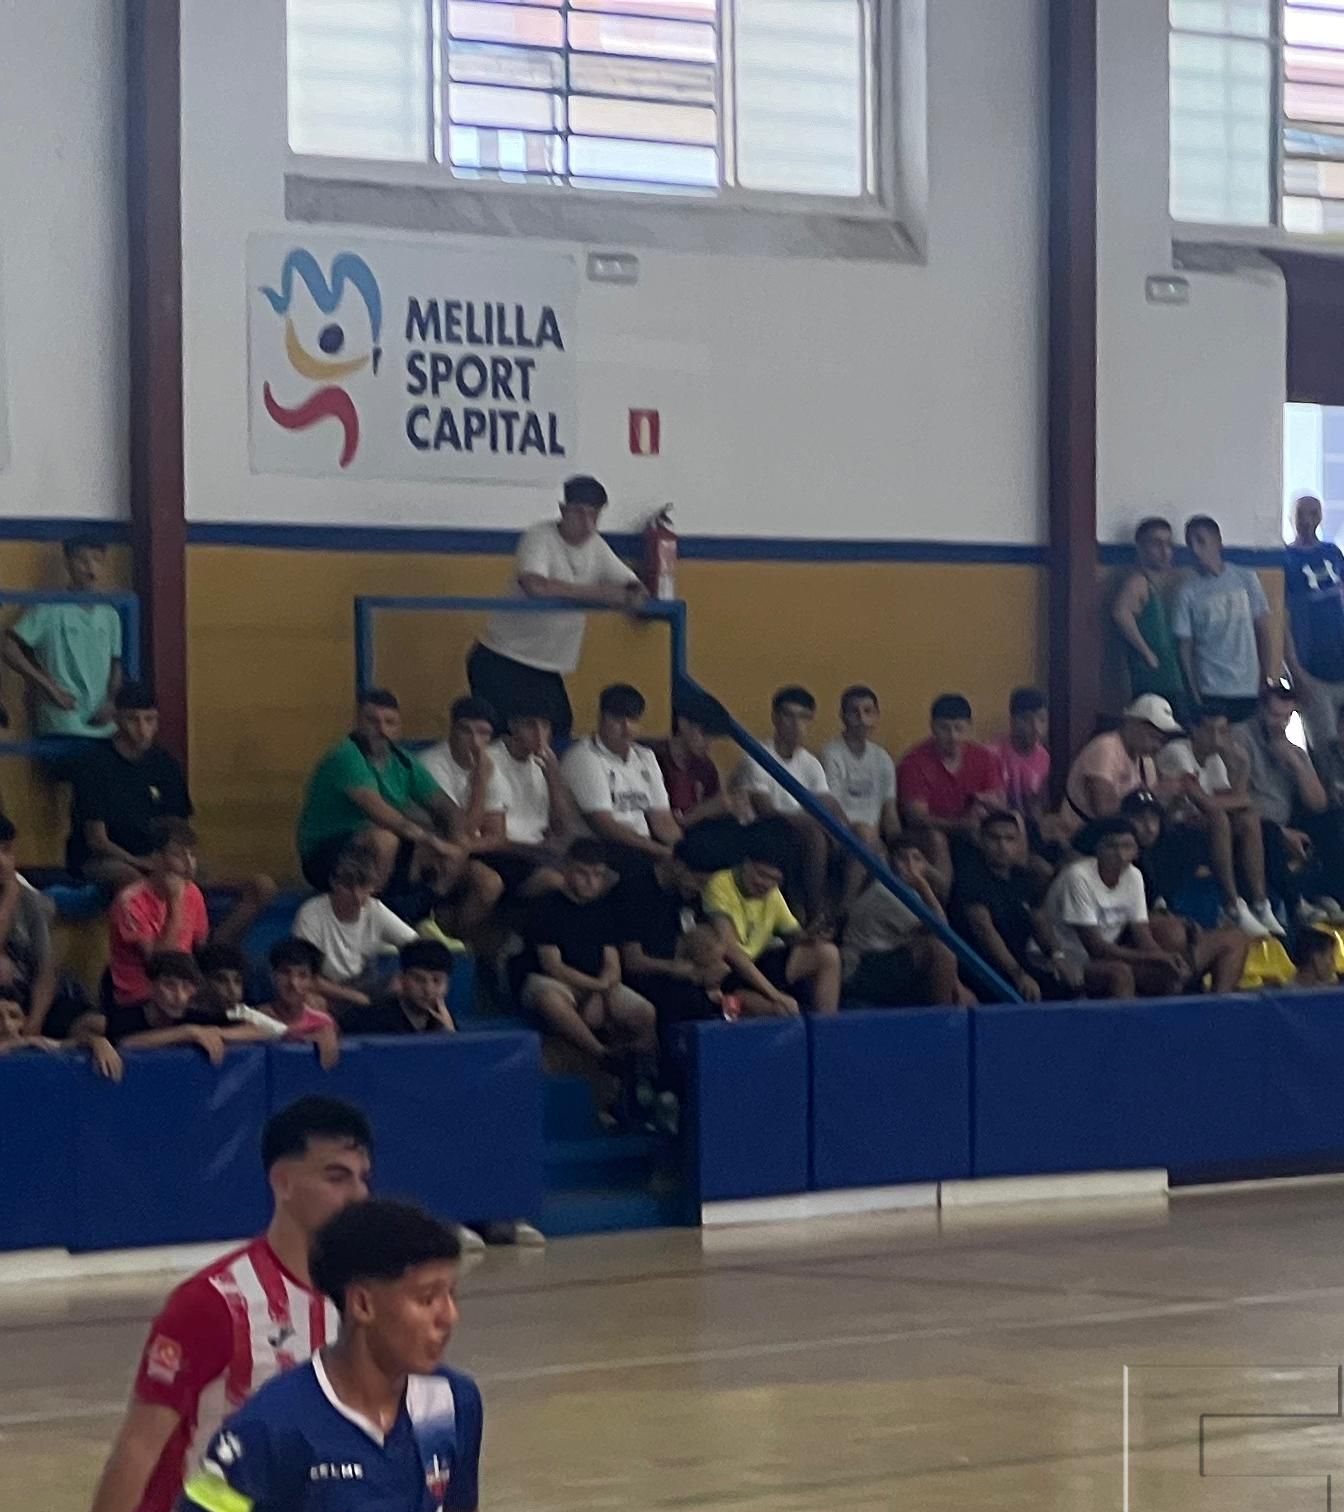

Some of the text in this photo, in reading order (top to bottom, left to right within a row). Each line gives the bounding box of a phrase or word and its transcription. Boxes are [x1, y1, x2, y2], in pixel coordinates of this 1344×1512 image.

[405, 296, 565, 351] MELILLA
[405, 350, 536, 402] SPORT
[405, 404, 567, 457] CAPITAL
